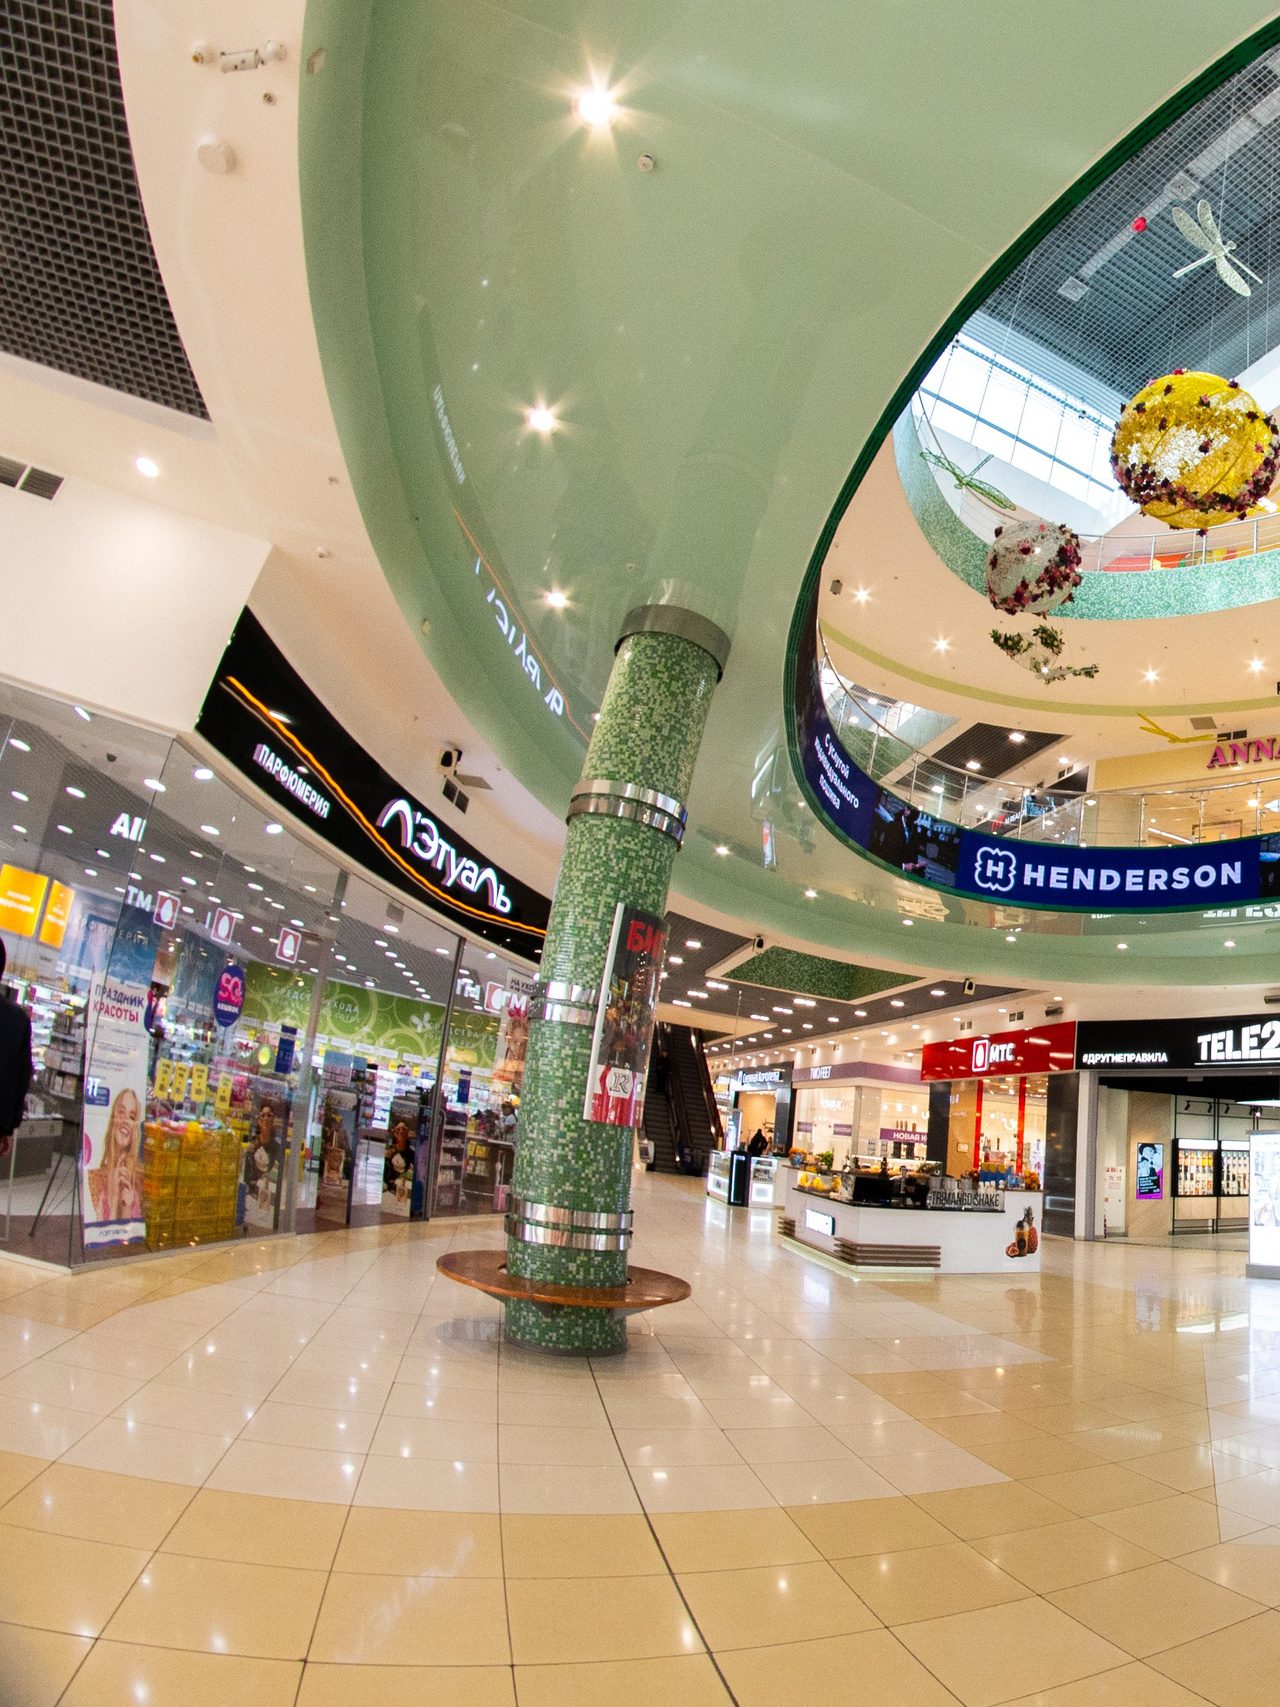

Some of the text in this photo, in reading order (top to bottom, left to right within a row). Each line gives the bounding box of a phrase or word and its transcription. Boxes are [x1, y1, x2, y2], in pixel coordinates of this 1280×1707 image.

[257, 744, 331, 818] ПАРФЮМЕРИЯ
[986, 859, 1242, 891] H HENDERSON
[94, 983, 145, 1009] ПРАЗДНИК
[92, 1001, 140, 1023] КРАСОТЫ
[988, 1043, 1015, 1062] МТС
[1082, 1052, 1167, 1065] #ДРУГИЕПРАВИЛА
[893, 1131, 920, 1142] НОВАЯ
